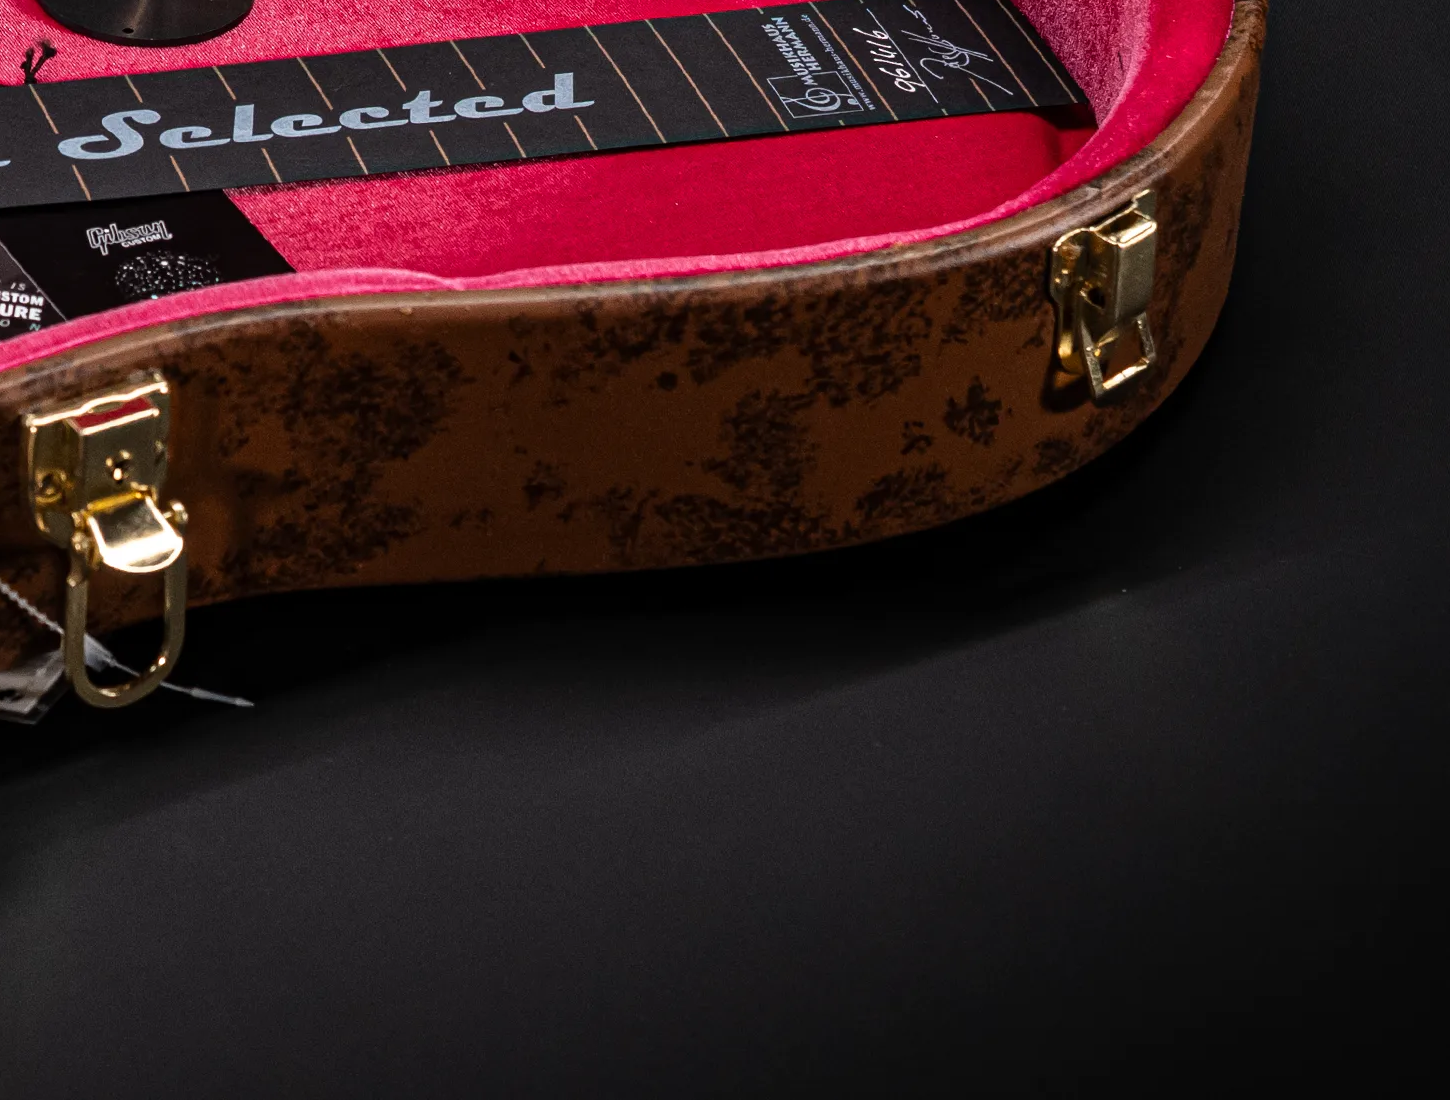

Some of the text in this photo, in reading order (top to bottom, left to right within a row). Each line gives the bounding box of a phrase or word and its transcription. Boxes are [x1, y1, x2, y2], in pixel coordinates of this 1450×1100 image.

[761, 23, 819, 87] MUSIKHAUS
[771, 16, 822, 79] HERMANN
[800, 13, 877, 112] www.musikhaus-hermann.de
[852, 26, 926, 93] 961416
[57, 72, 595, 161] Selected
[86, 220, 174, 256] Gibson
[121, 233, 162, 248] CUSTOM
[10, 282, 26, 291] IS
